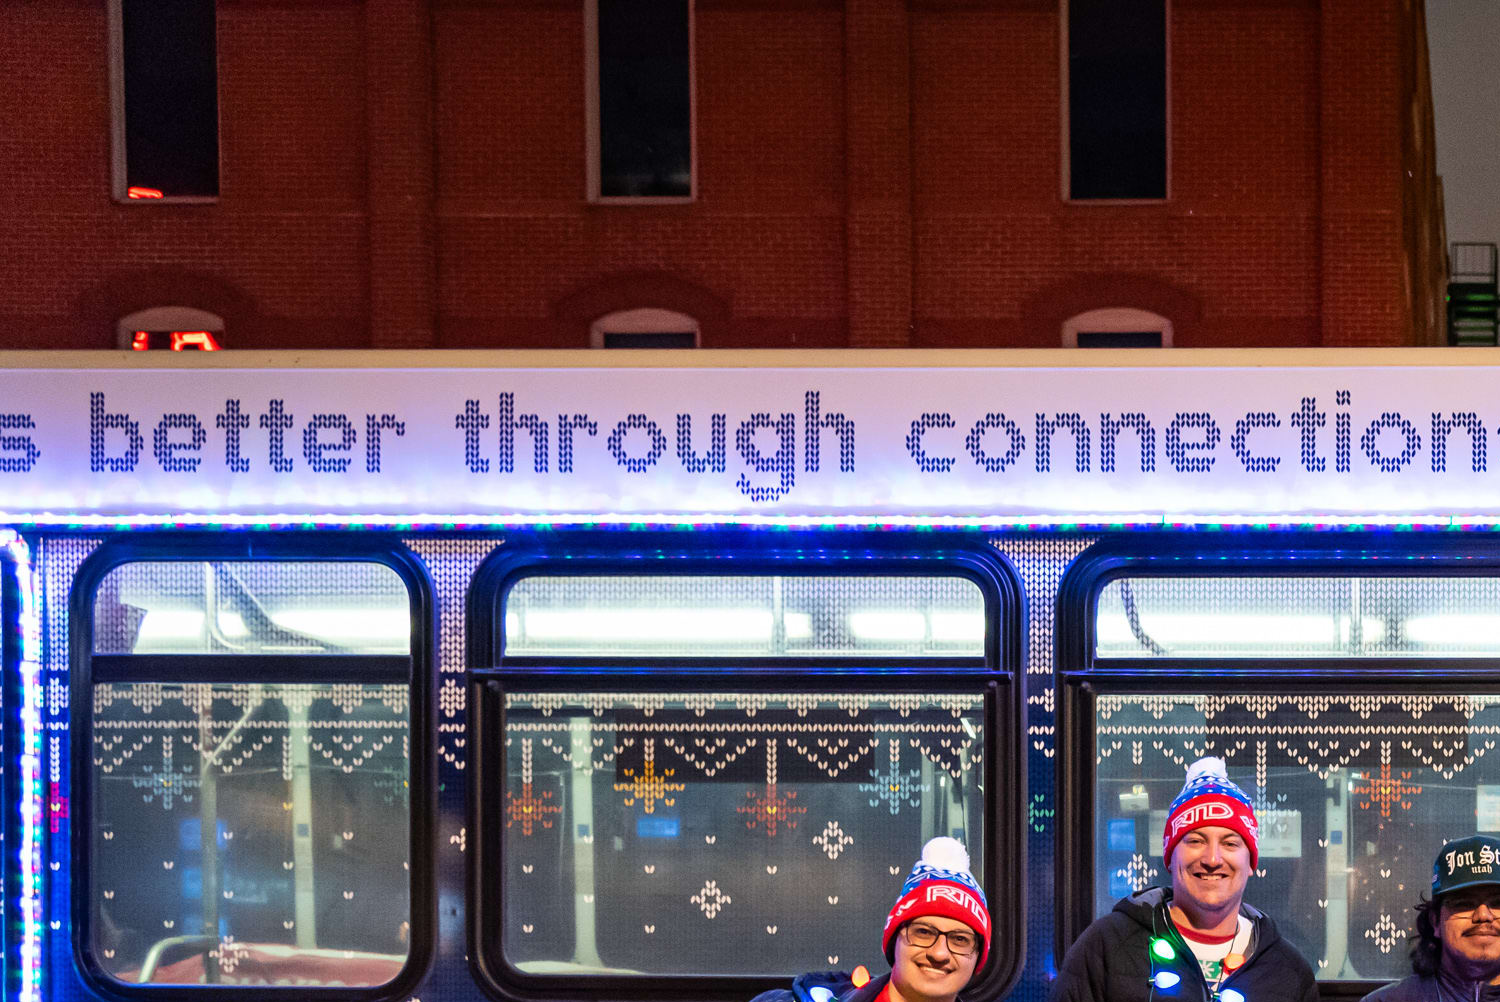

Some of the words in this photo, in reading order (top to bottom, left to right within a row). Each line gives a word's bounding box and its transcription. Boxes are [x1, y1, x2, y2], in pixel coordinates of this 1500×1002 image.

[0, 413, 40, 473] s
[90, 391, 406, 473] better
[455, 390, 855, 503] through
[1171, 802, 1234, 837] RTD
[1446, 850, 1475, 876] Jon
[1471, 864, 1493, 874] utah
[926, 885, 988, 929] RTD
